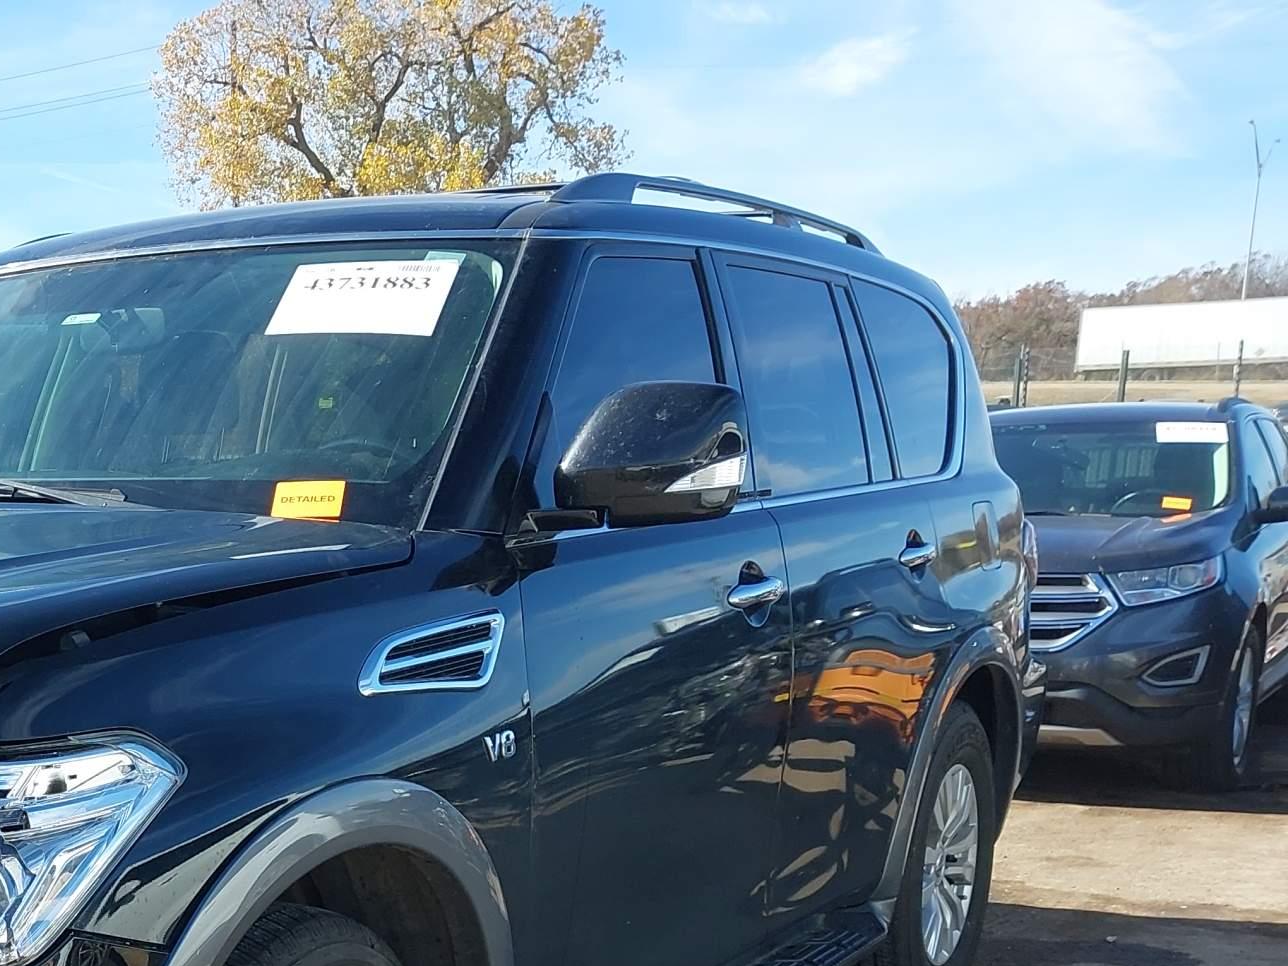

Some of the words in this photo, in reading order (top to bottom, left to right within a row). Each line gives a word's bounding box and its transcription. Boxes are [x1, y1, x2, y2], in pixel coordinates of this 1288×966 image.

[303, 276, 432, 291] 43731883
[280, 495, 336, 504] DETAILED
[482, 730, 517, 762] V8
